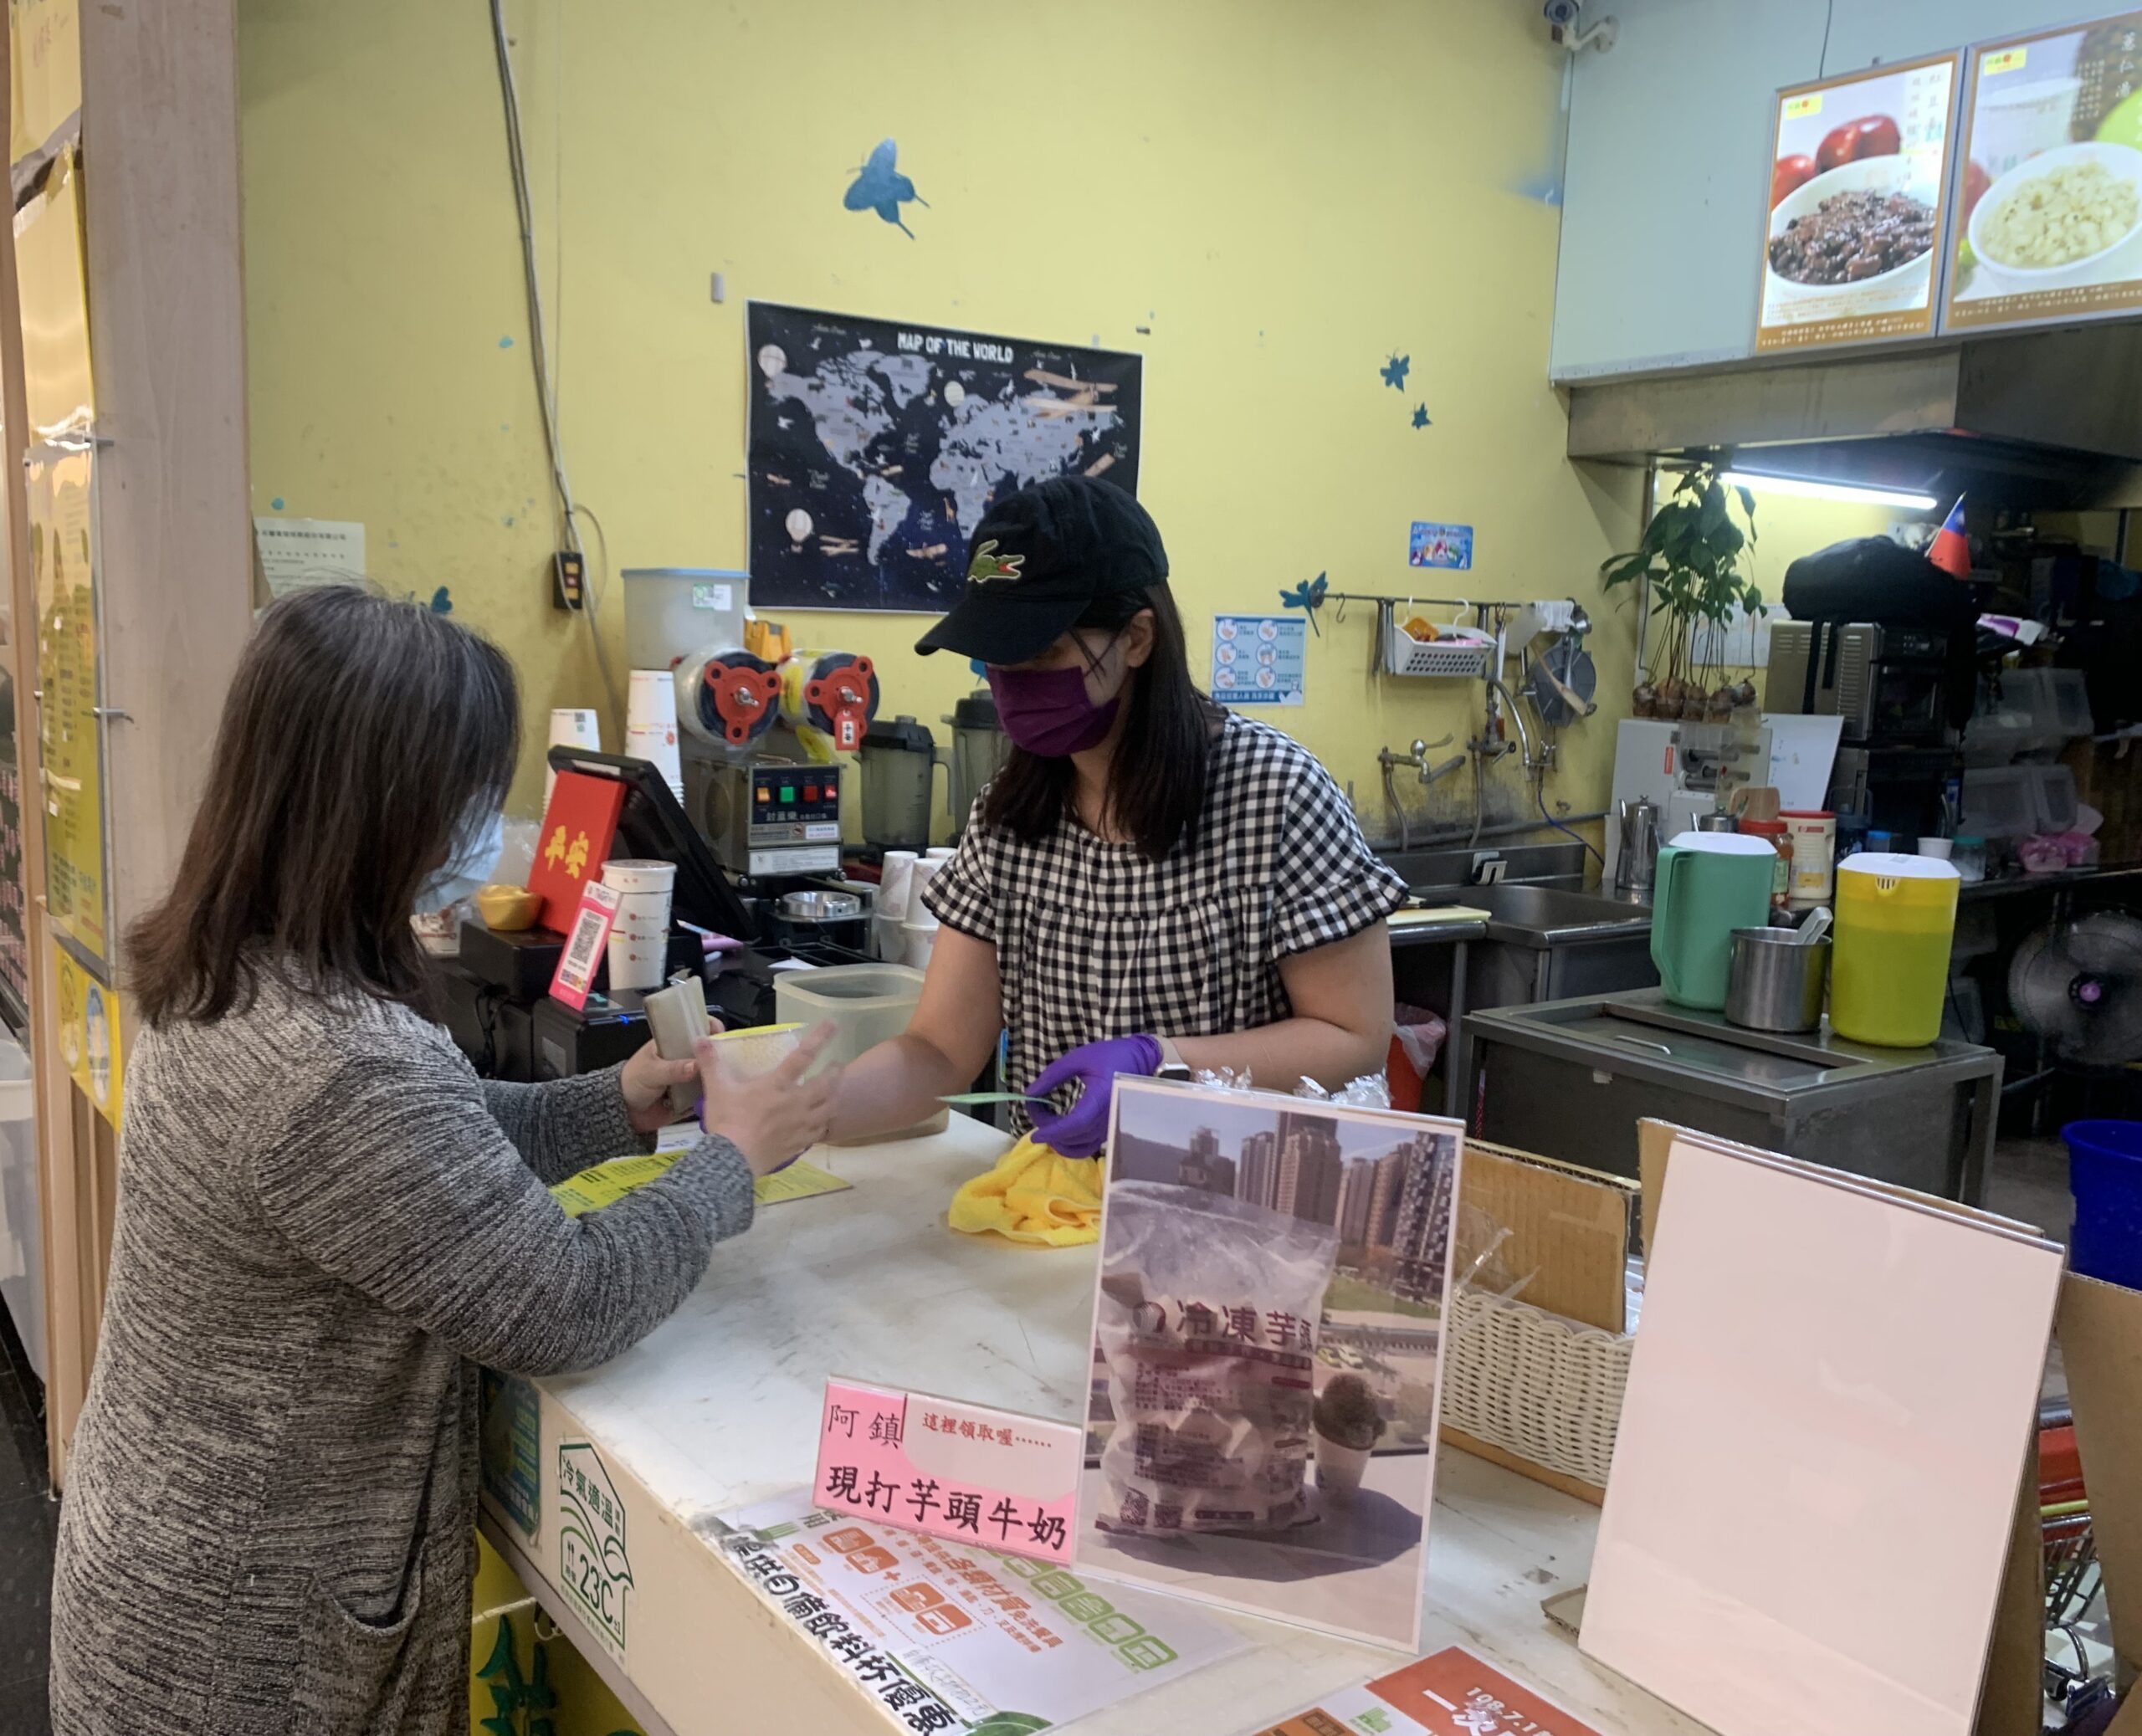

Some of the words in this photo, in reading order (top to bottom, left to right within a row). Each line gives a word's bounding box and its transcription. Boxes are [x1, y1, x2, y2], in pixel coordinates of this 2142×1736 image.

[897, 332, 924, 352] MAP
[925, 335, 943, 355] OF
[946, 338, 971, 358] THE
[973, 341, 1014, 364] WORLD
[828, 1405, 902, 1449] 阿鎮
[562, 1455, 613, 1529] 冷氣適溫
[825, 1466, 1066, 1550] 現打芋頭牛奶
